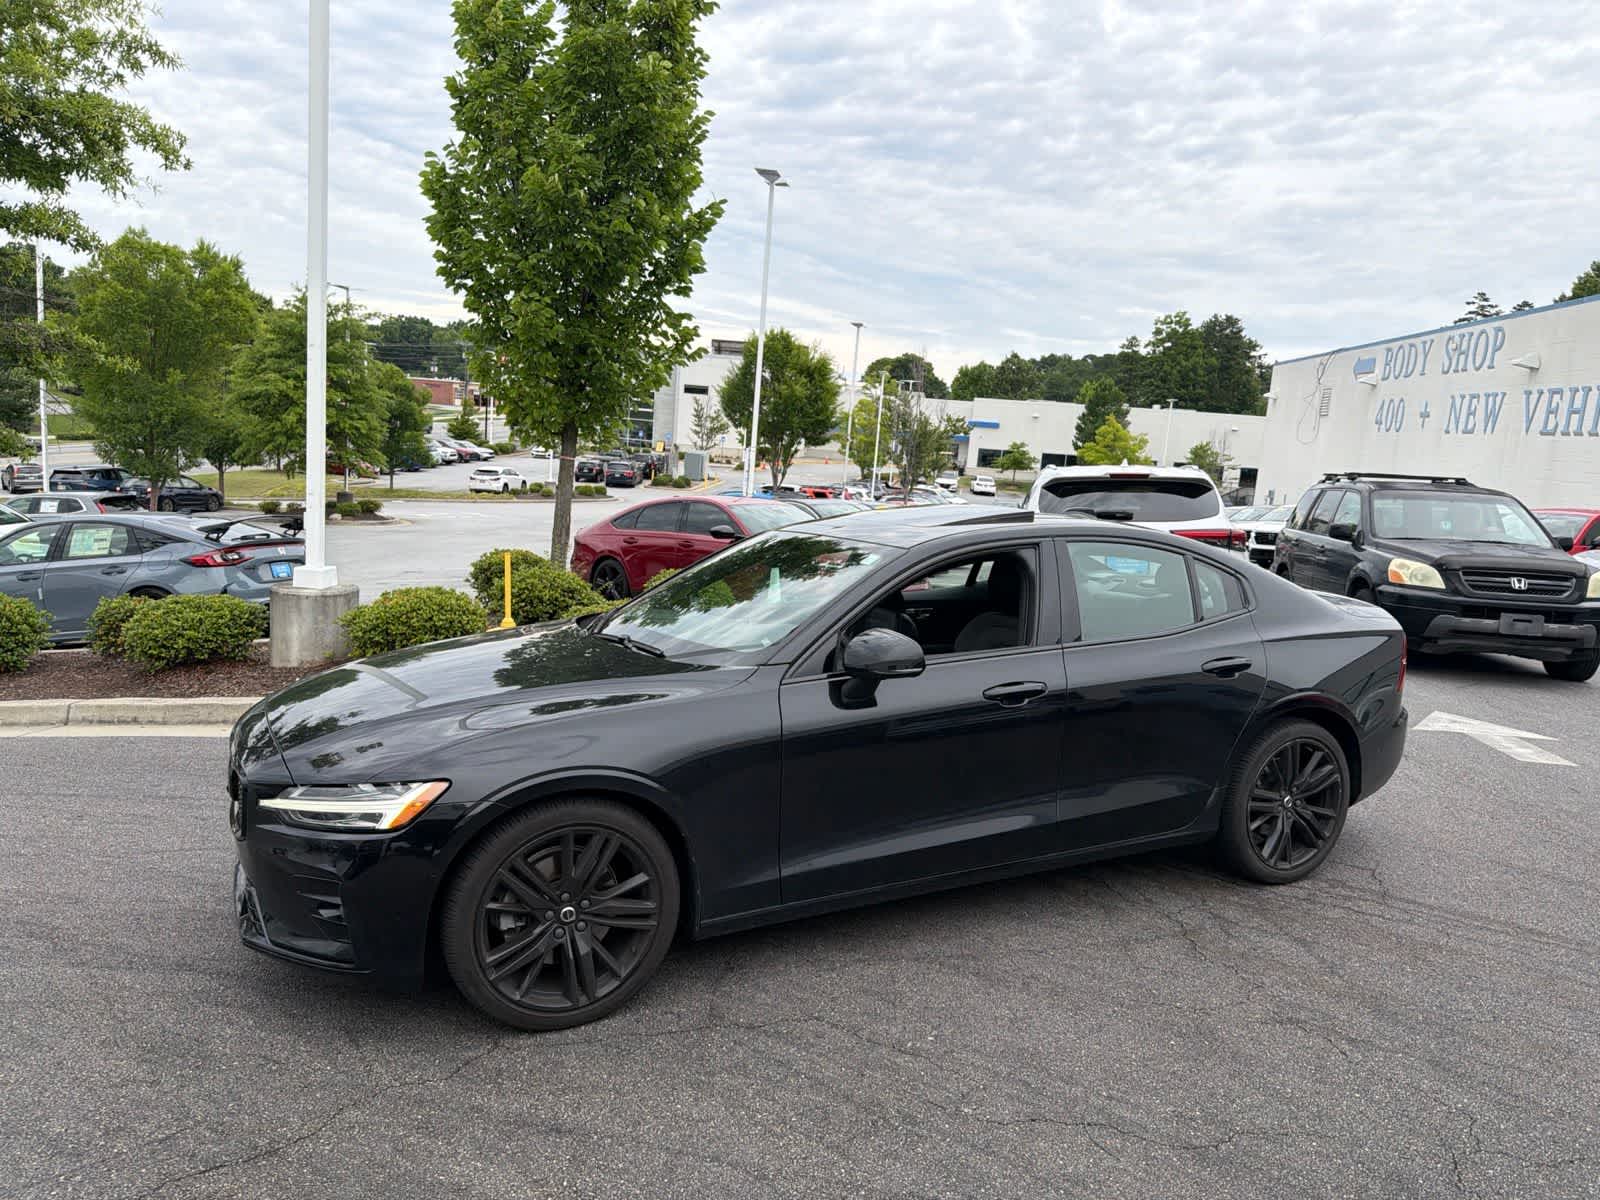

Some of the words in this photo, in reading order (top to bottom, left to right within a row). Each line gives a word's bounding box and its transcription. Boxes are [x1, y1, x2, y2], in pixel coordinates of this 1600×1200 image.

[1381, 339, 1434, 381] BODY
[1441, 326, 1506, 375] SHOP
[1375, 397, 1405, 433] 400
[1444, 391, 1507, 435] NEW
